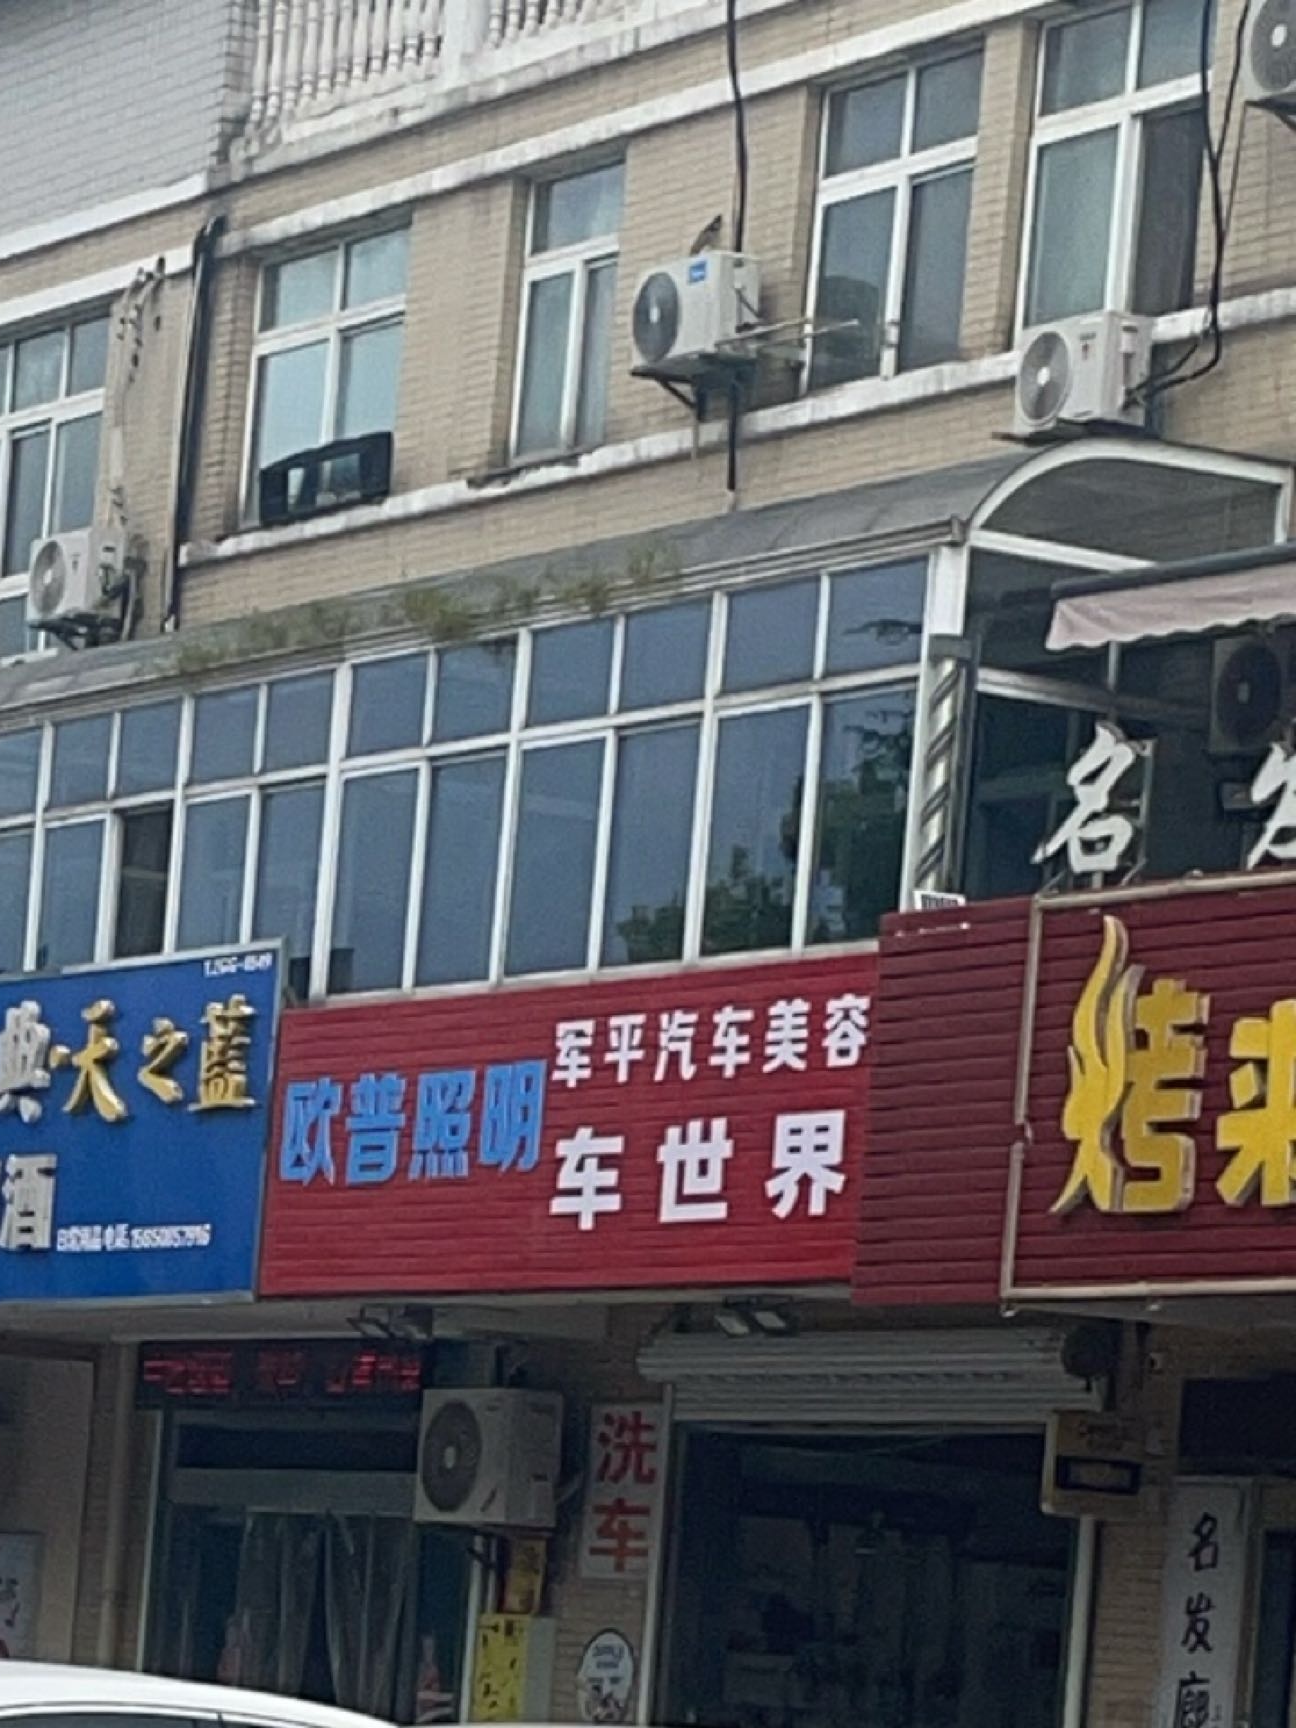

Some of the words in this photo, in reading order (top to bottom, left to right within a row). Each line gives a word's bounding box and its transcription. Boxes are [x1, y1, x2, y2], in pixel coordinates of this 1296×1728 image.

[551, 993, 872, 1089] 军平汽车美容
[279, 1059, 548, 1186] 欧普照明
[549, 1110, 846, 1231] 车世界
[589, 1411, 657, 1573] 洗车
